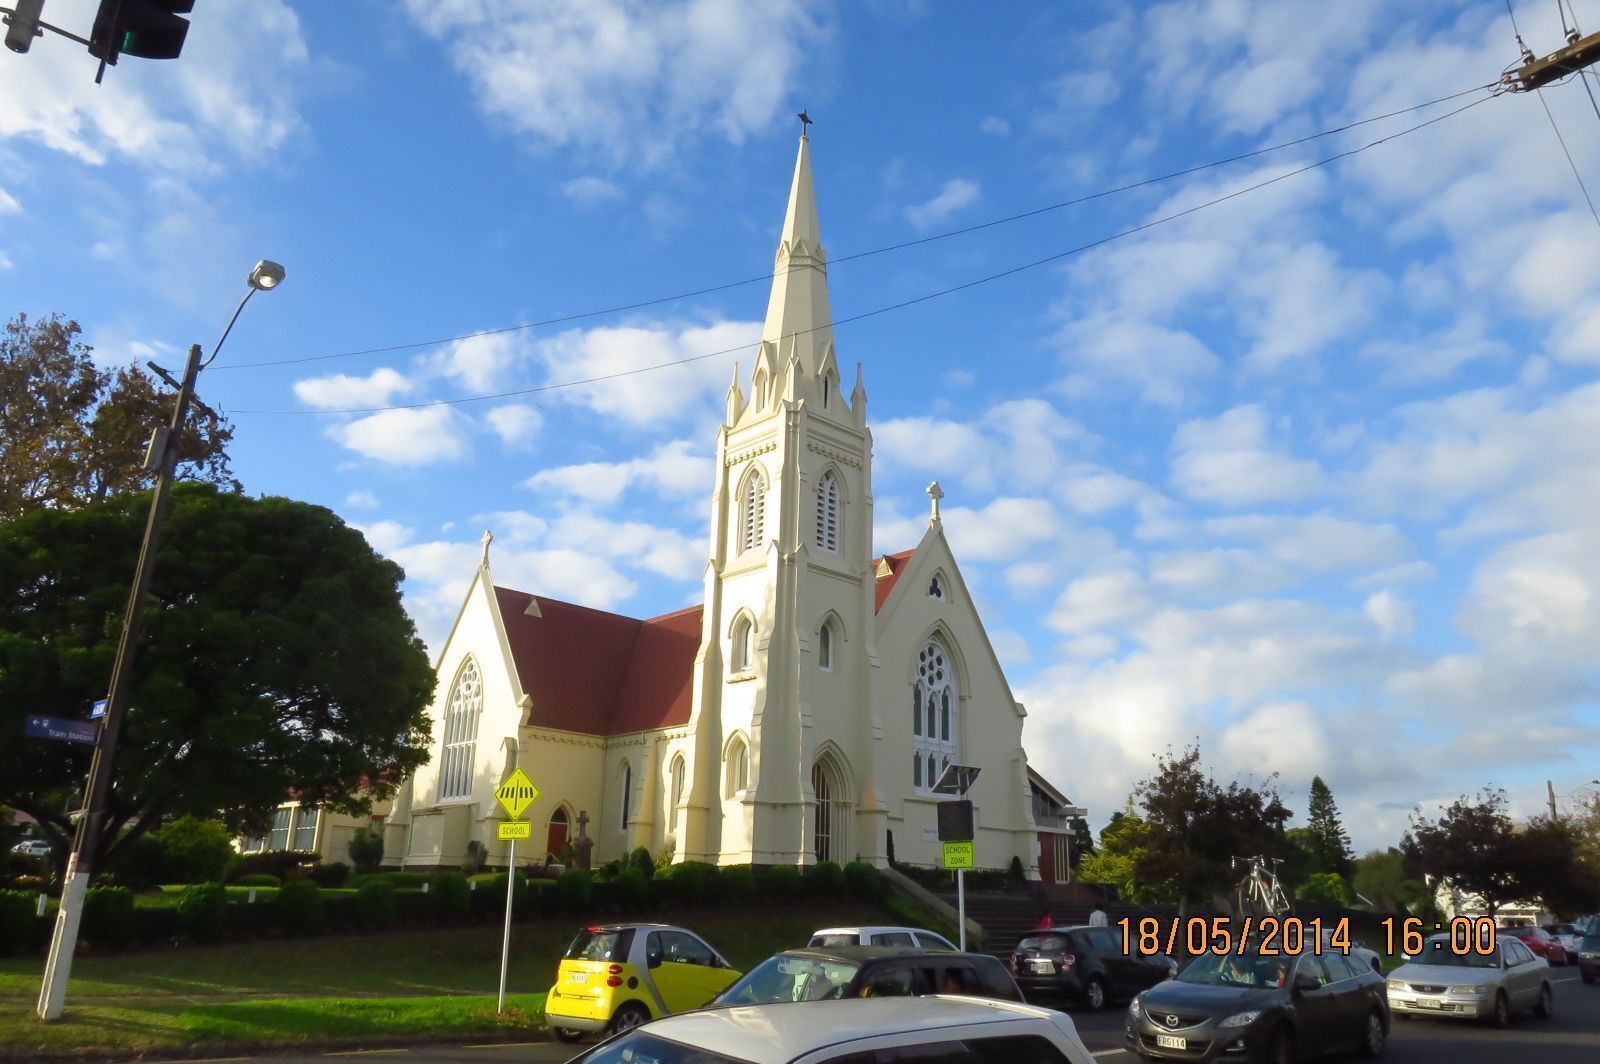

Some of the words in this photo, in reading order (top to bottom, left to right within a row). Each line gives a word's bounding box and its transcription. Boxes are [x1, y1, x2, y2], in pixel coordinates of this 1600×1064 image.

[48, 729, 67, 738] Train
[67, 731, 95, 742] Station
[502, 826, 526, 835] SCHOOL
[945, 846, 970, 855] SCHOOL
[950, 856, 966, 865] ZONE
